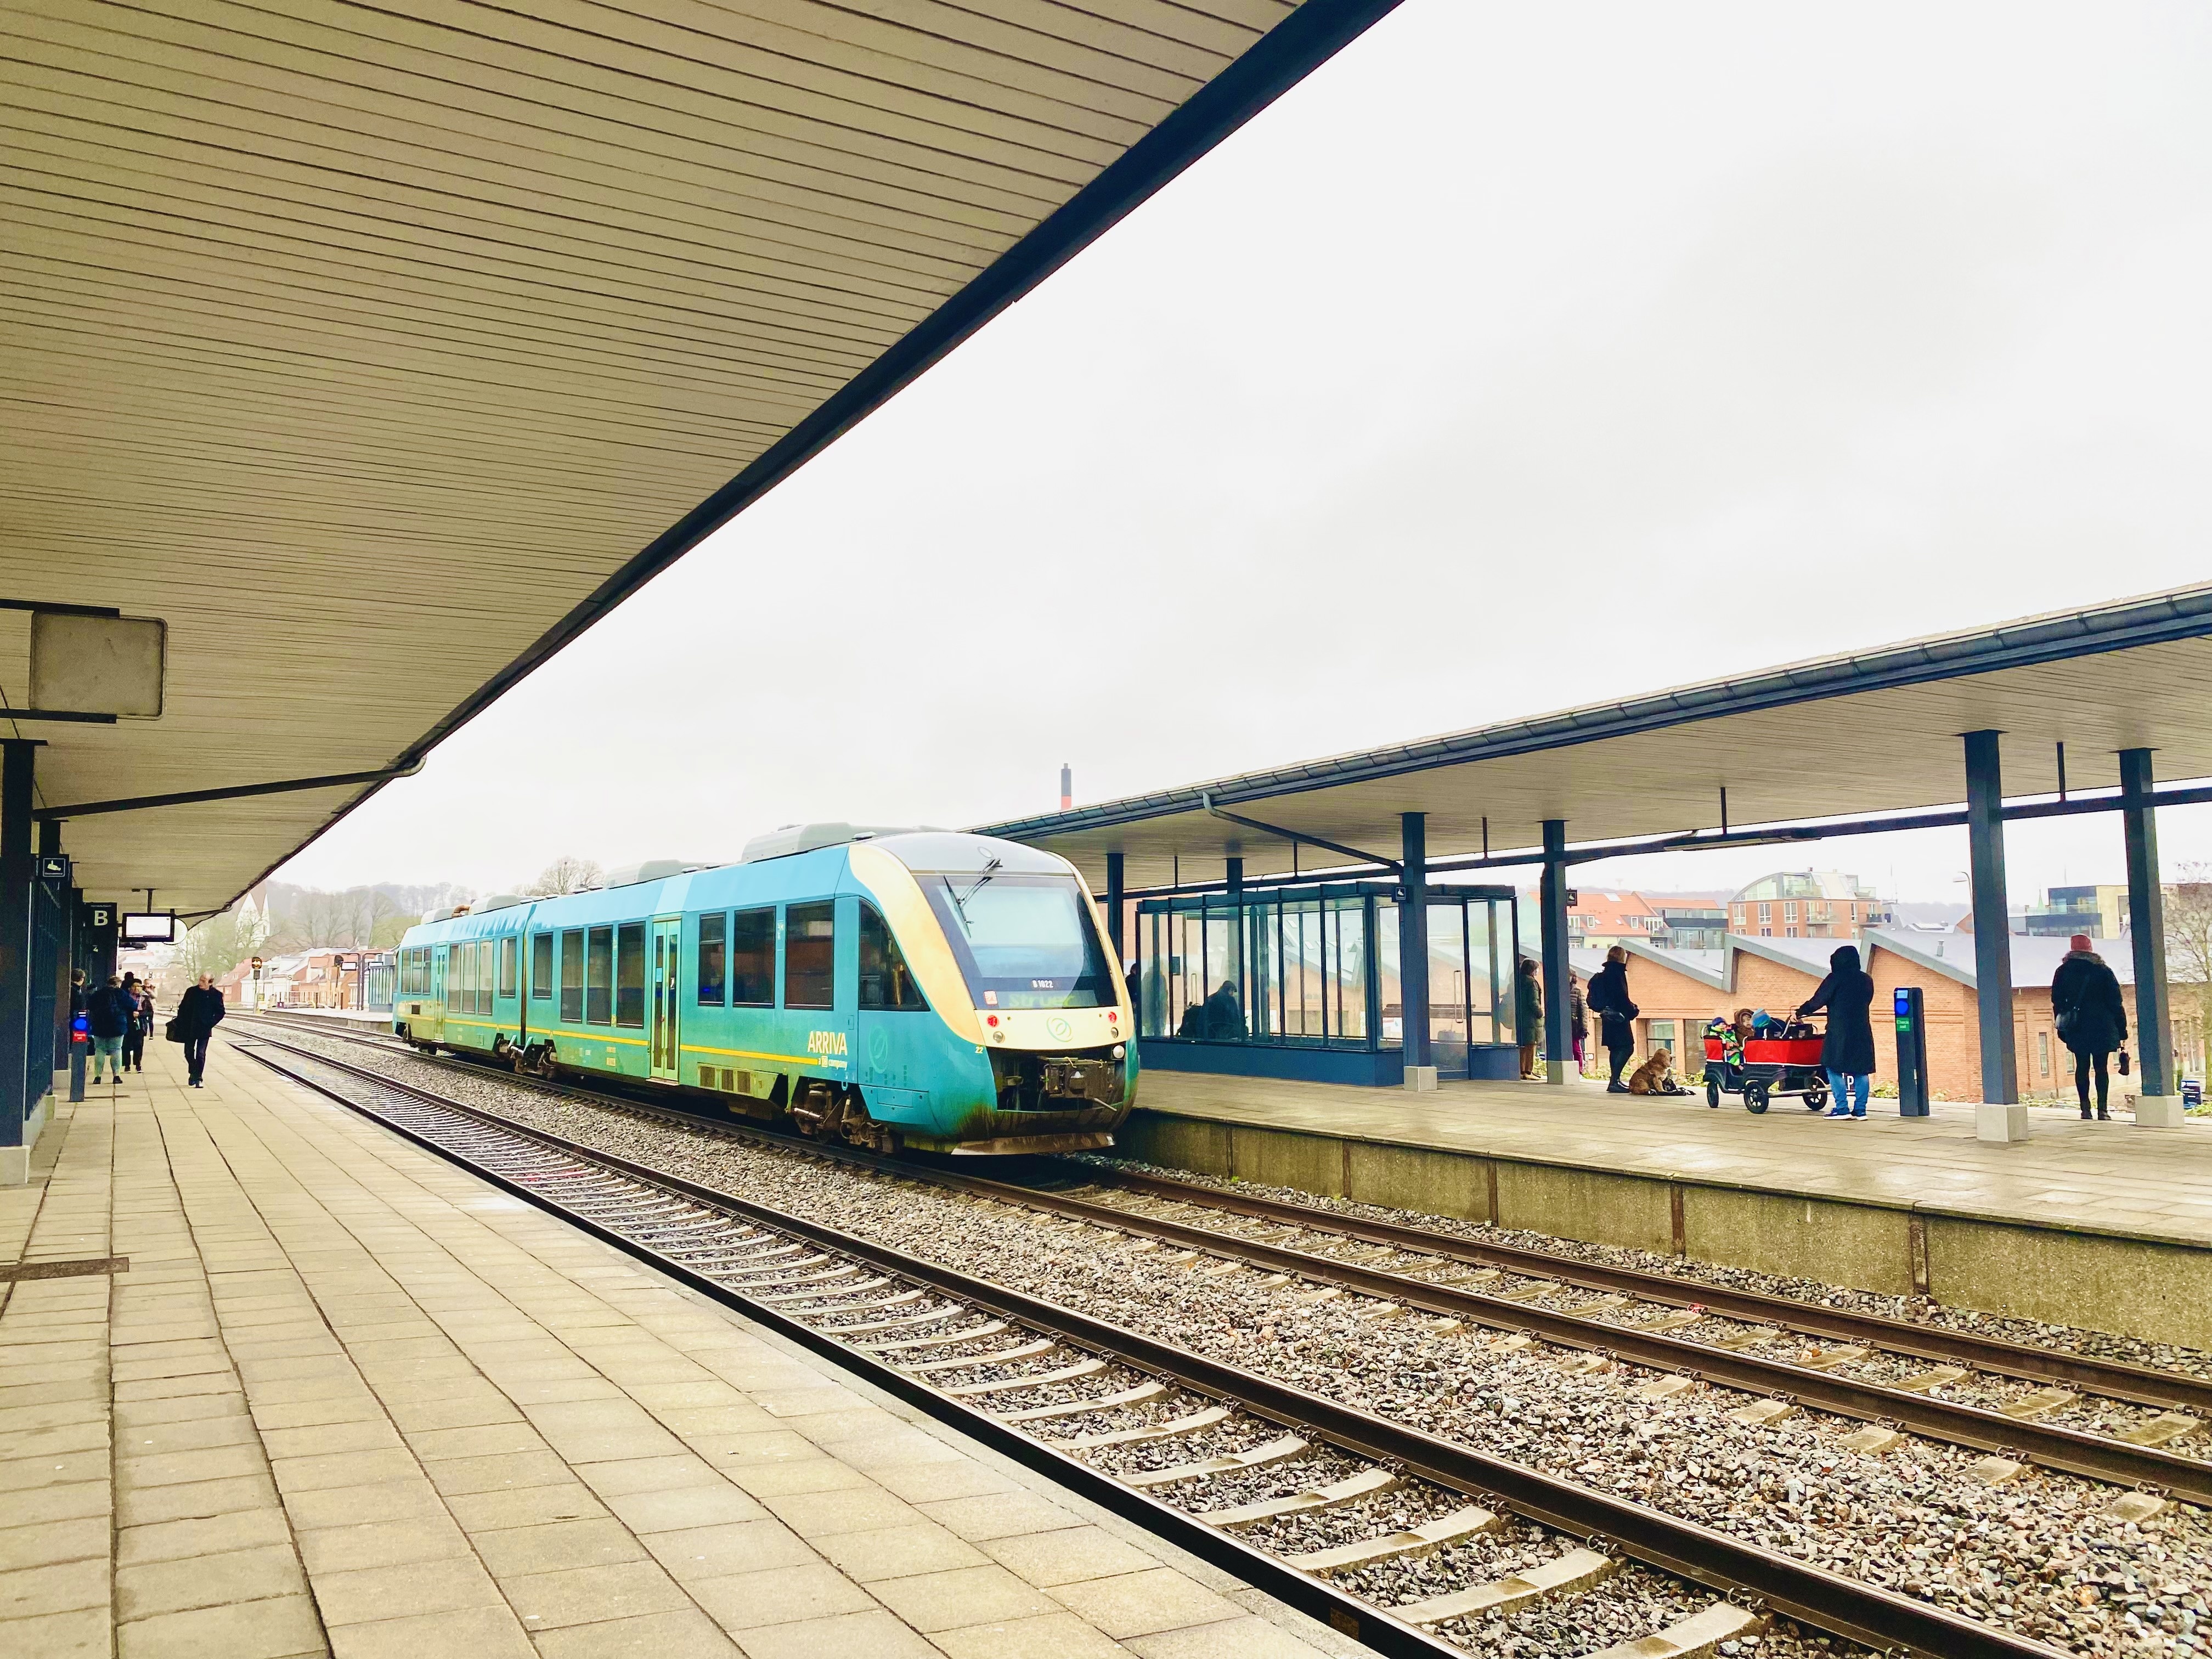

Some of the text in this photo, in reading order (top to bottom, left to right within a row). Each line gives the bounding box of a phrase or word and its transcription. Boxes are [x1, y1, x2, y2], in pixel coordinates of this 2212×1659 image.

[94, 911, 108, 926] B
[1037, 980, 1054, 988] 1022
[1009, 993, 1074, 1008] Struer
[808, 1031, 848, 1056] ARRIVA
